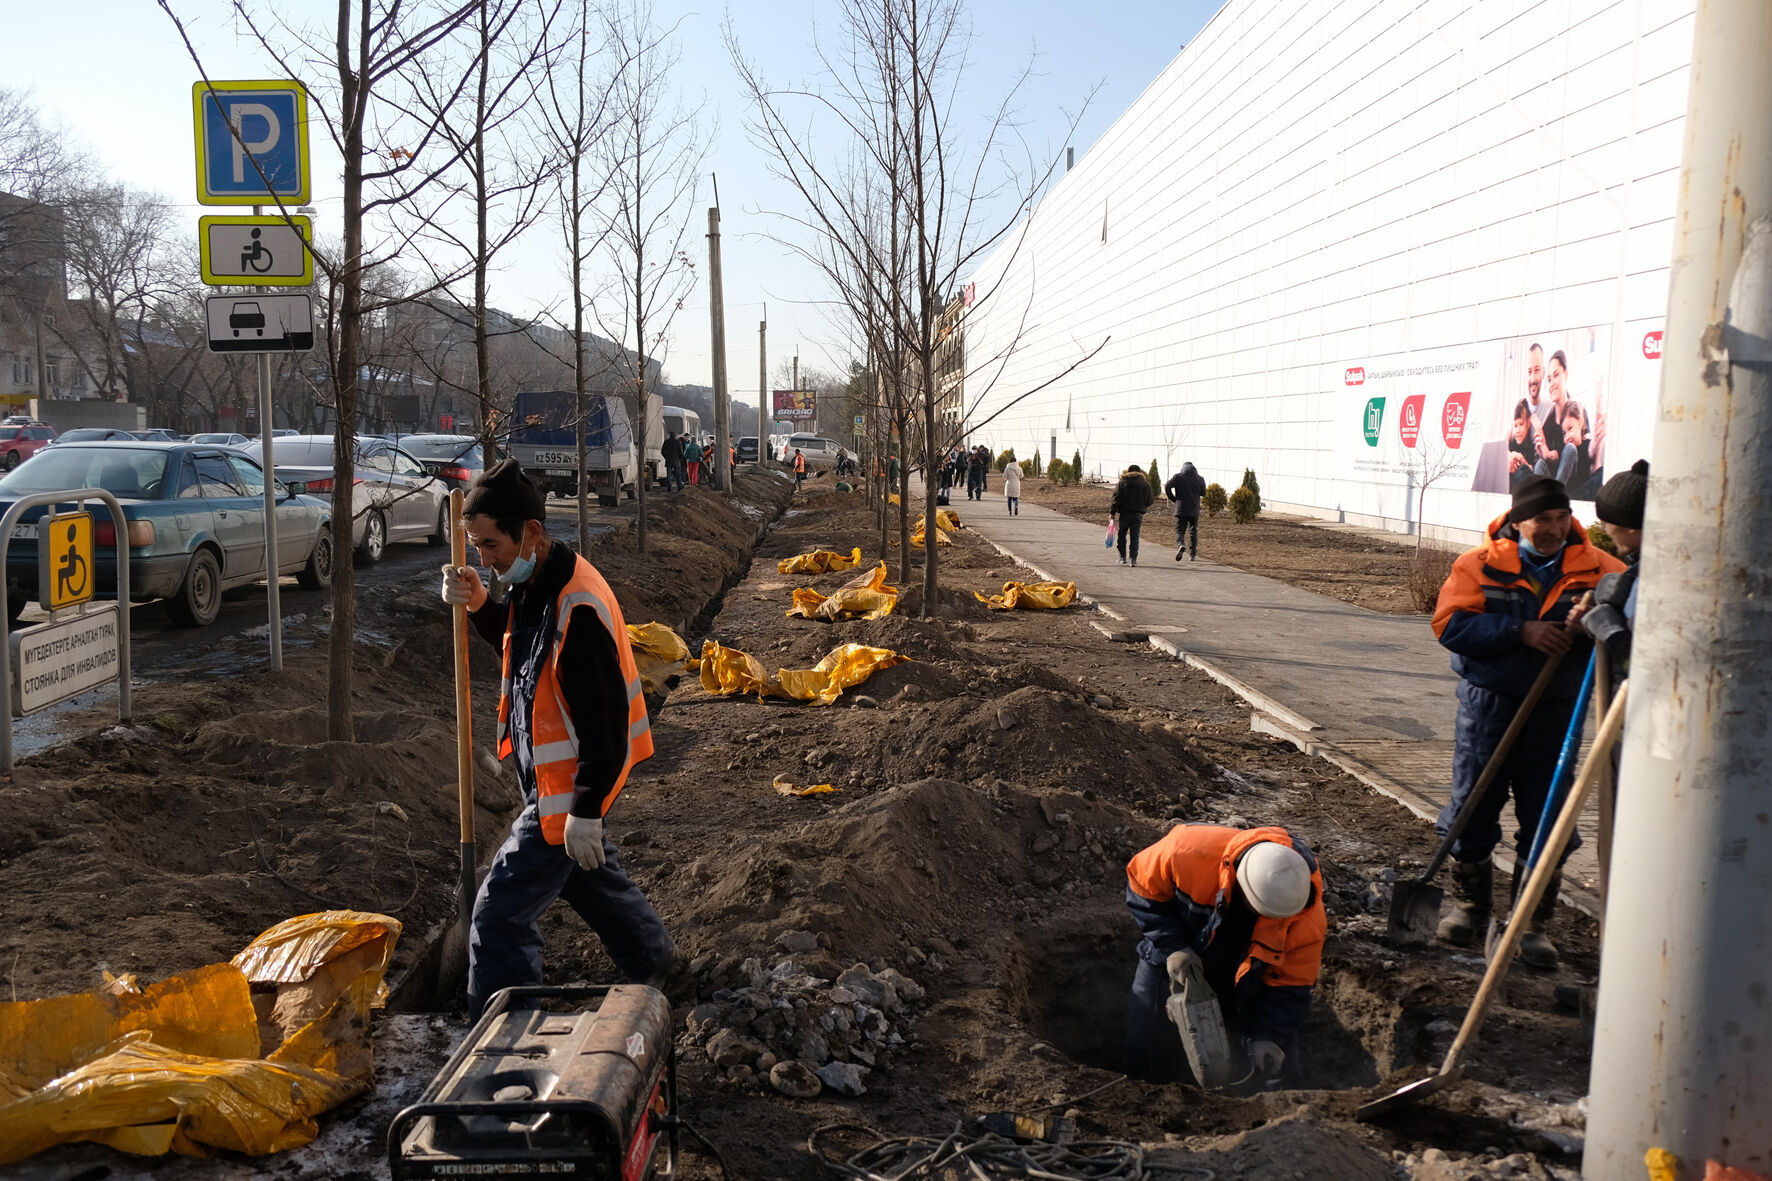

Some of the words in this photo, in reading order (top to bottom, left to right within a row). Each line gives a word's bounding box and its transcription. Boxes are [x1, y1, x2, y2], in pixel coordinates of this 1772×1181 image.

[230, 103, 280, 182] P
[545, 452, 562, 464] 595
[24, 669, 59, 695] СТОЯНКА
[60, 663, 75, 684] ДЛЯ
[76, 648, 116, 676] ИНВАЛИДОВ
